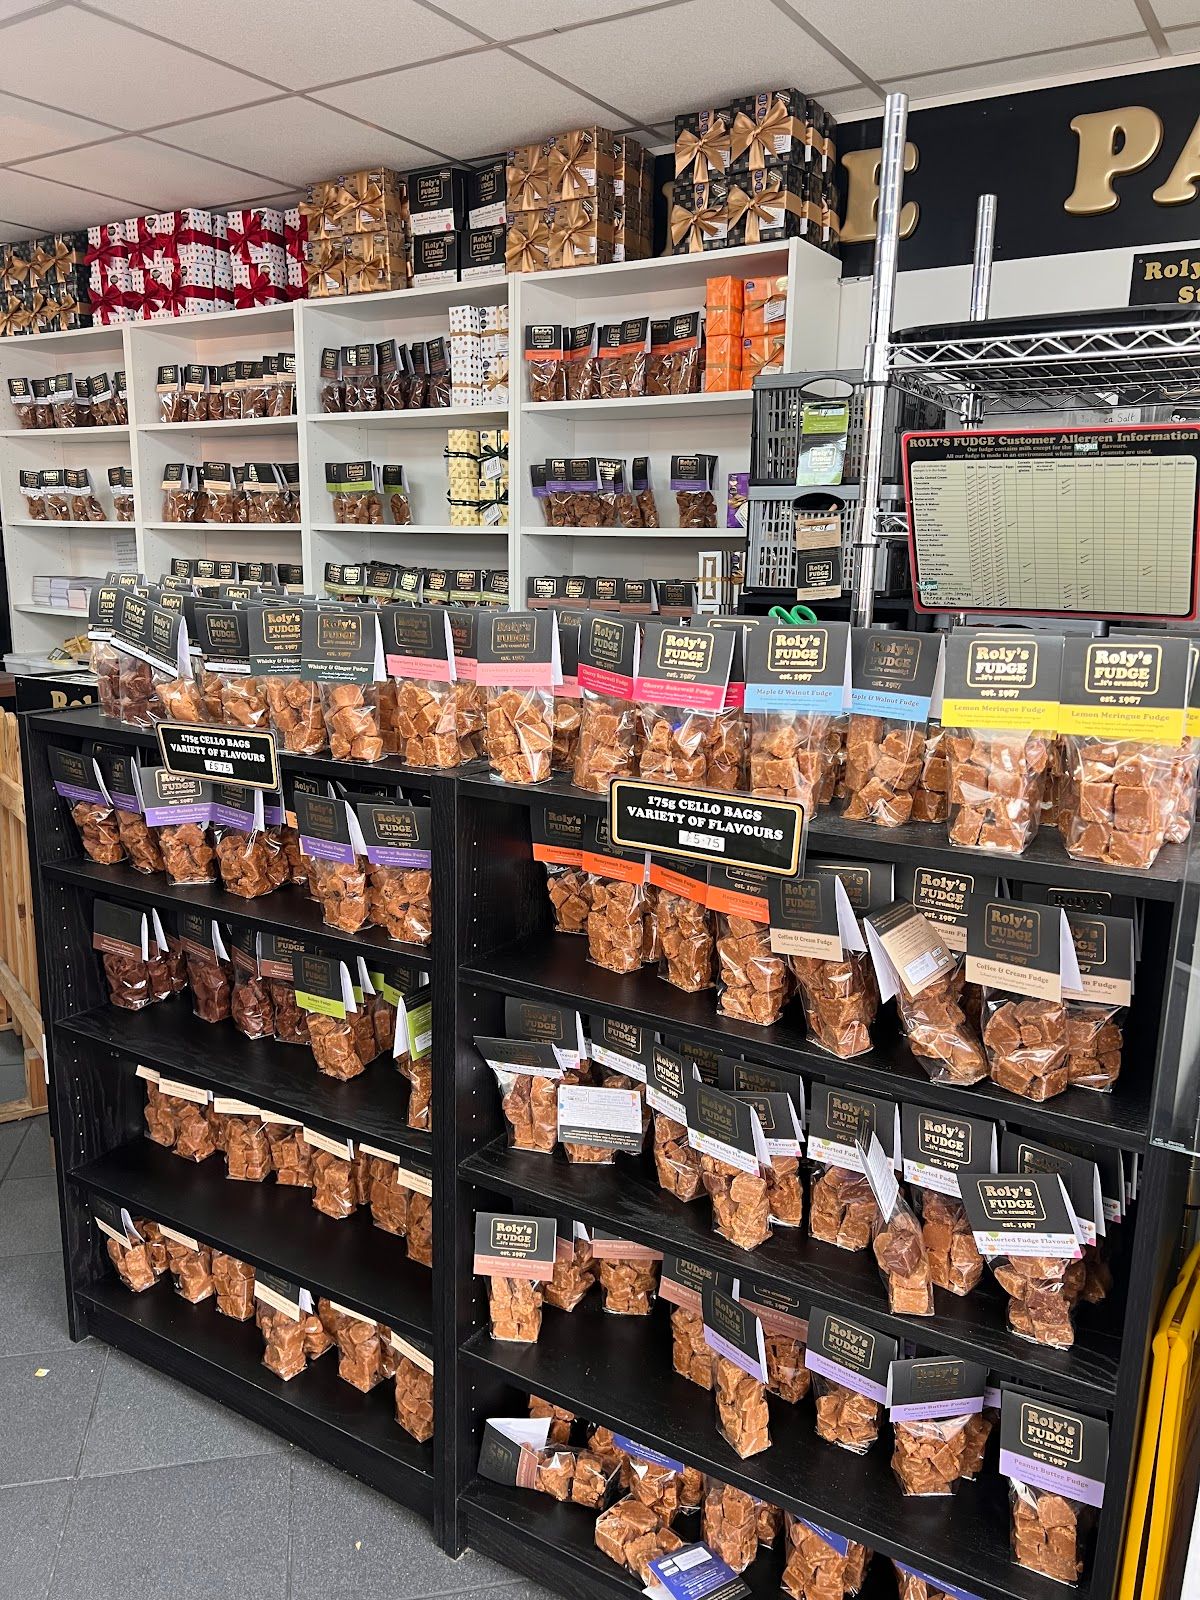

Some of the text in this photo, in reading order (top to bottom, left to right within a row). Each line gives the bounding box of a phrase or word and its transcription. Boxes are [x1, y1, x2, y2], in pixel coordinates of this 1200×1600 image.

[473, 242, 492, 250] FUDGE
[910, 432, 1198, 447] ROLY'S FUDGE Customer Allergen Information
[267, 614, 300, 623] Roly's
[323, 618, 356, 629] Roly's
[268, 624, 300, 633] FUDGE
[497, 621, 531, 633] Roly's
[594, 623, 620, 638] Roly's
[323, 631, 356, 639] FUDGE
[496, 634, 531, 643] FUDGE
[666, 634, 707, 650] Roly's
[776, 634, 821, 648] Roly's
[594, 637, 618, 652] FUDGE
[872, 642, 914, 656] Roly's
[664, 648, 704, 661] FUDGE
[775, 649, 818, 659] FUDGE
[976, 647, 1029, 661] Roly's
[1095, 650, 1152, 666] Roly's
[872, 656, 911, 668] FUDGE
[975, 662, 1028, 674] FUDGE
[1094, 667, 1150, 680] FUDGE
[757, 688, 777, 696] Maple
[875, 696, 919, 707] Walnut Fudge
[982, 705, 1019, 714] Meringue
[1071, 711, 1170, 722] Lemon Meringue Fudge
[181, 734, 250, 749] 175g CELLO BAGS
[170, 743, 266, 762] VARIETY OF FLAVOURS
[162, 782, 196, 791] FUDGE
[294, 781, 316, 793] Roly's
[647, 795, 762, 821] 175g CELLO BAGS
[377, 813, 411, 824] Roly's
[548, 811, 582, 825] Roly's
[627, 806, 784, 841] VARIETY OF FLAVOURS
[379, 824, 412, 832] FUDGE
[548, 823, 582, 834] FUDGE
[921, 873, 967, 891] Roly's
[785, 884, 816, 896] Roly's
[920, 887, 965, 904] FUDGE
[785, 899, 816, 909] FUDGE
[939, 914, 957, 923] 1987
[991, 910, 1034, 928] Roly's
[990, 926, 1032, 943] FUDGE
[277, 941, 305, 953] FUDGE
[976, 962, 998, 973] Coffee
[1005, 968, 1026, 978] Cream
[1028, 974, 1049, 984] Fudge
[1092, 980, 1117, 990] Fudge
[608, 1027, 637, 1044] FUDGE
[656, 1052, 679, 1072] Roly's
[656, 1065, 679, 1083] FUDGE
[701, 1094, 732, 1115] Roly's
[832, 1097, 871, 1117] Roly's
[702, 1107, 732, 1124] FUDGE
[924, 1120, 966, 1139] Roly's
[924, 1133, 964, 1150] FUDGE
[930, 1157, 942, 1165] est.
[913, 1164, 938, 1178] Assorted
[984, 1186, 1032, 1198] Roly's
[988, 1200, 1035, 1209] FUDGE
[496, 1222, 532, 1235] Roly's
[496, 1234, 532, 1243] FUDGE
[680, 1260, 712, 1280] FUDGE
[830, 1322, 868, 1348] Roly's
[829, 1334, 866, 1358] FUDGE
[1028, 1410, 1075, 1436] Roly's
[1028, 1425, 1074, 1449] FUDGE
[1033, 1451, 1046, 1460] est.
[1014, 1458, 1039, 1471] Peanut
[1040, 1467, 1065, 1480] Butter
[1067, 1473, 1089, 1488] Fudge
